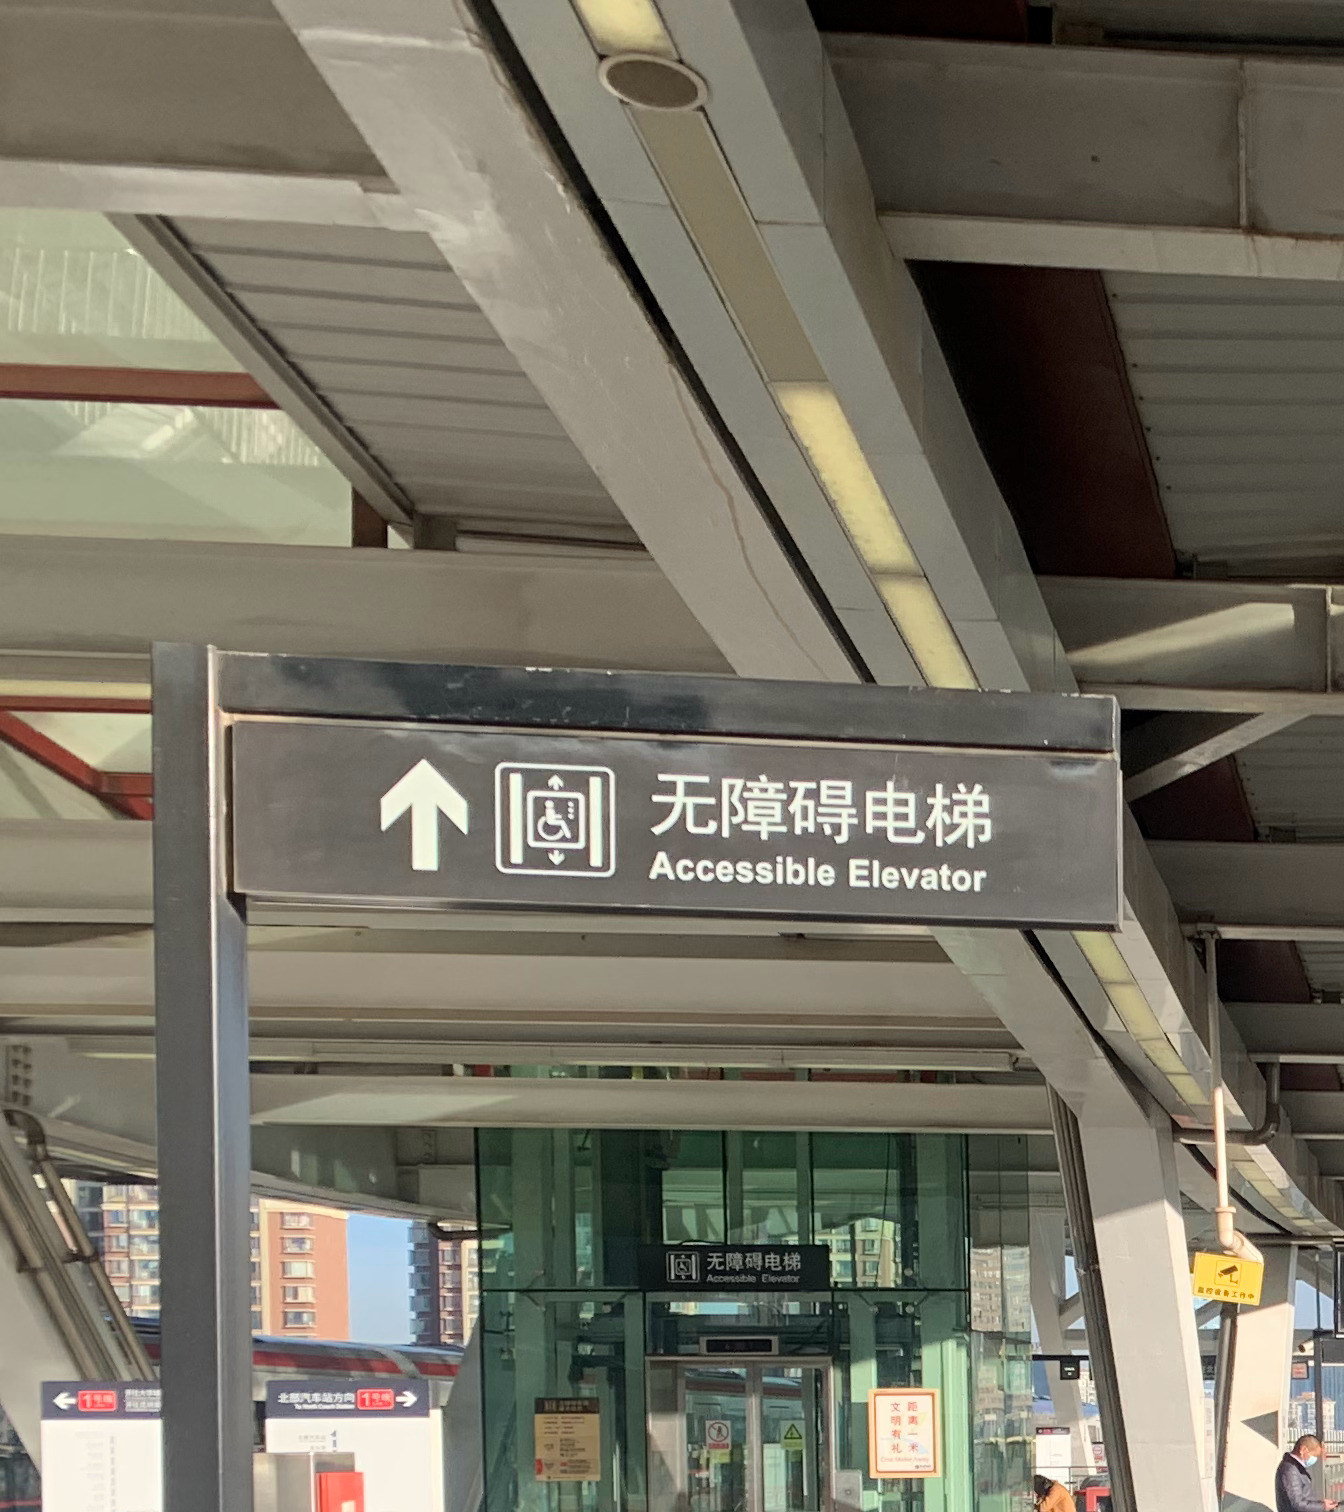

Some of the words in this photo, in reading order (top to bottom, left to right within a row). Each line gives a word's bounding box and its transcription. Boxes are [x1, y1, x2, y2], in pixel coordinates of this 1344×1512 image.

[650, 773, 993, 849] 无障碍电梯
[648, 850, 836, 887] Accessible
[848, 858, 988, 892] Elevator
[706, 1252, 801, 1272] 无障碍电梯
[706, 1273, 757, 1284] Accessible
[761, 1273, 800, 1284] Elevator
